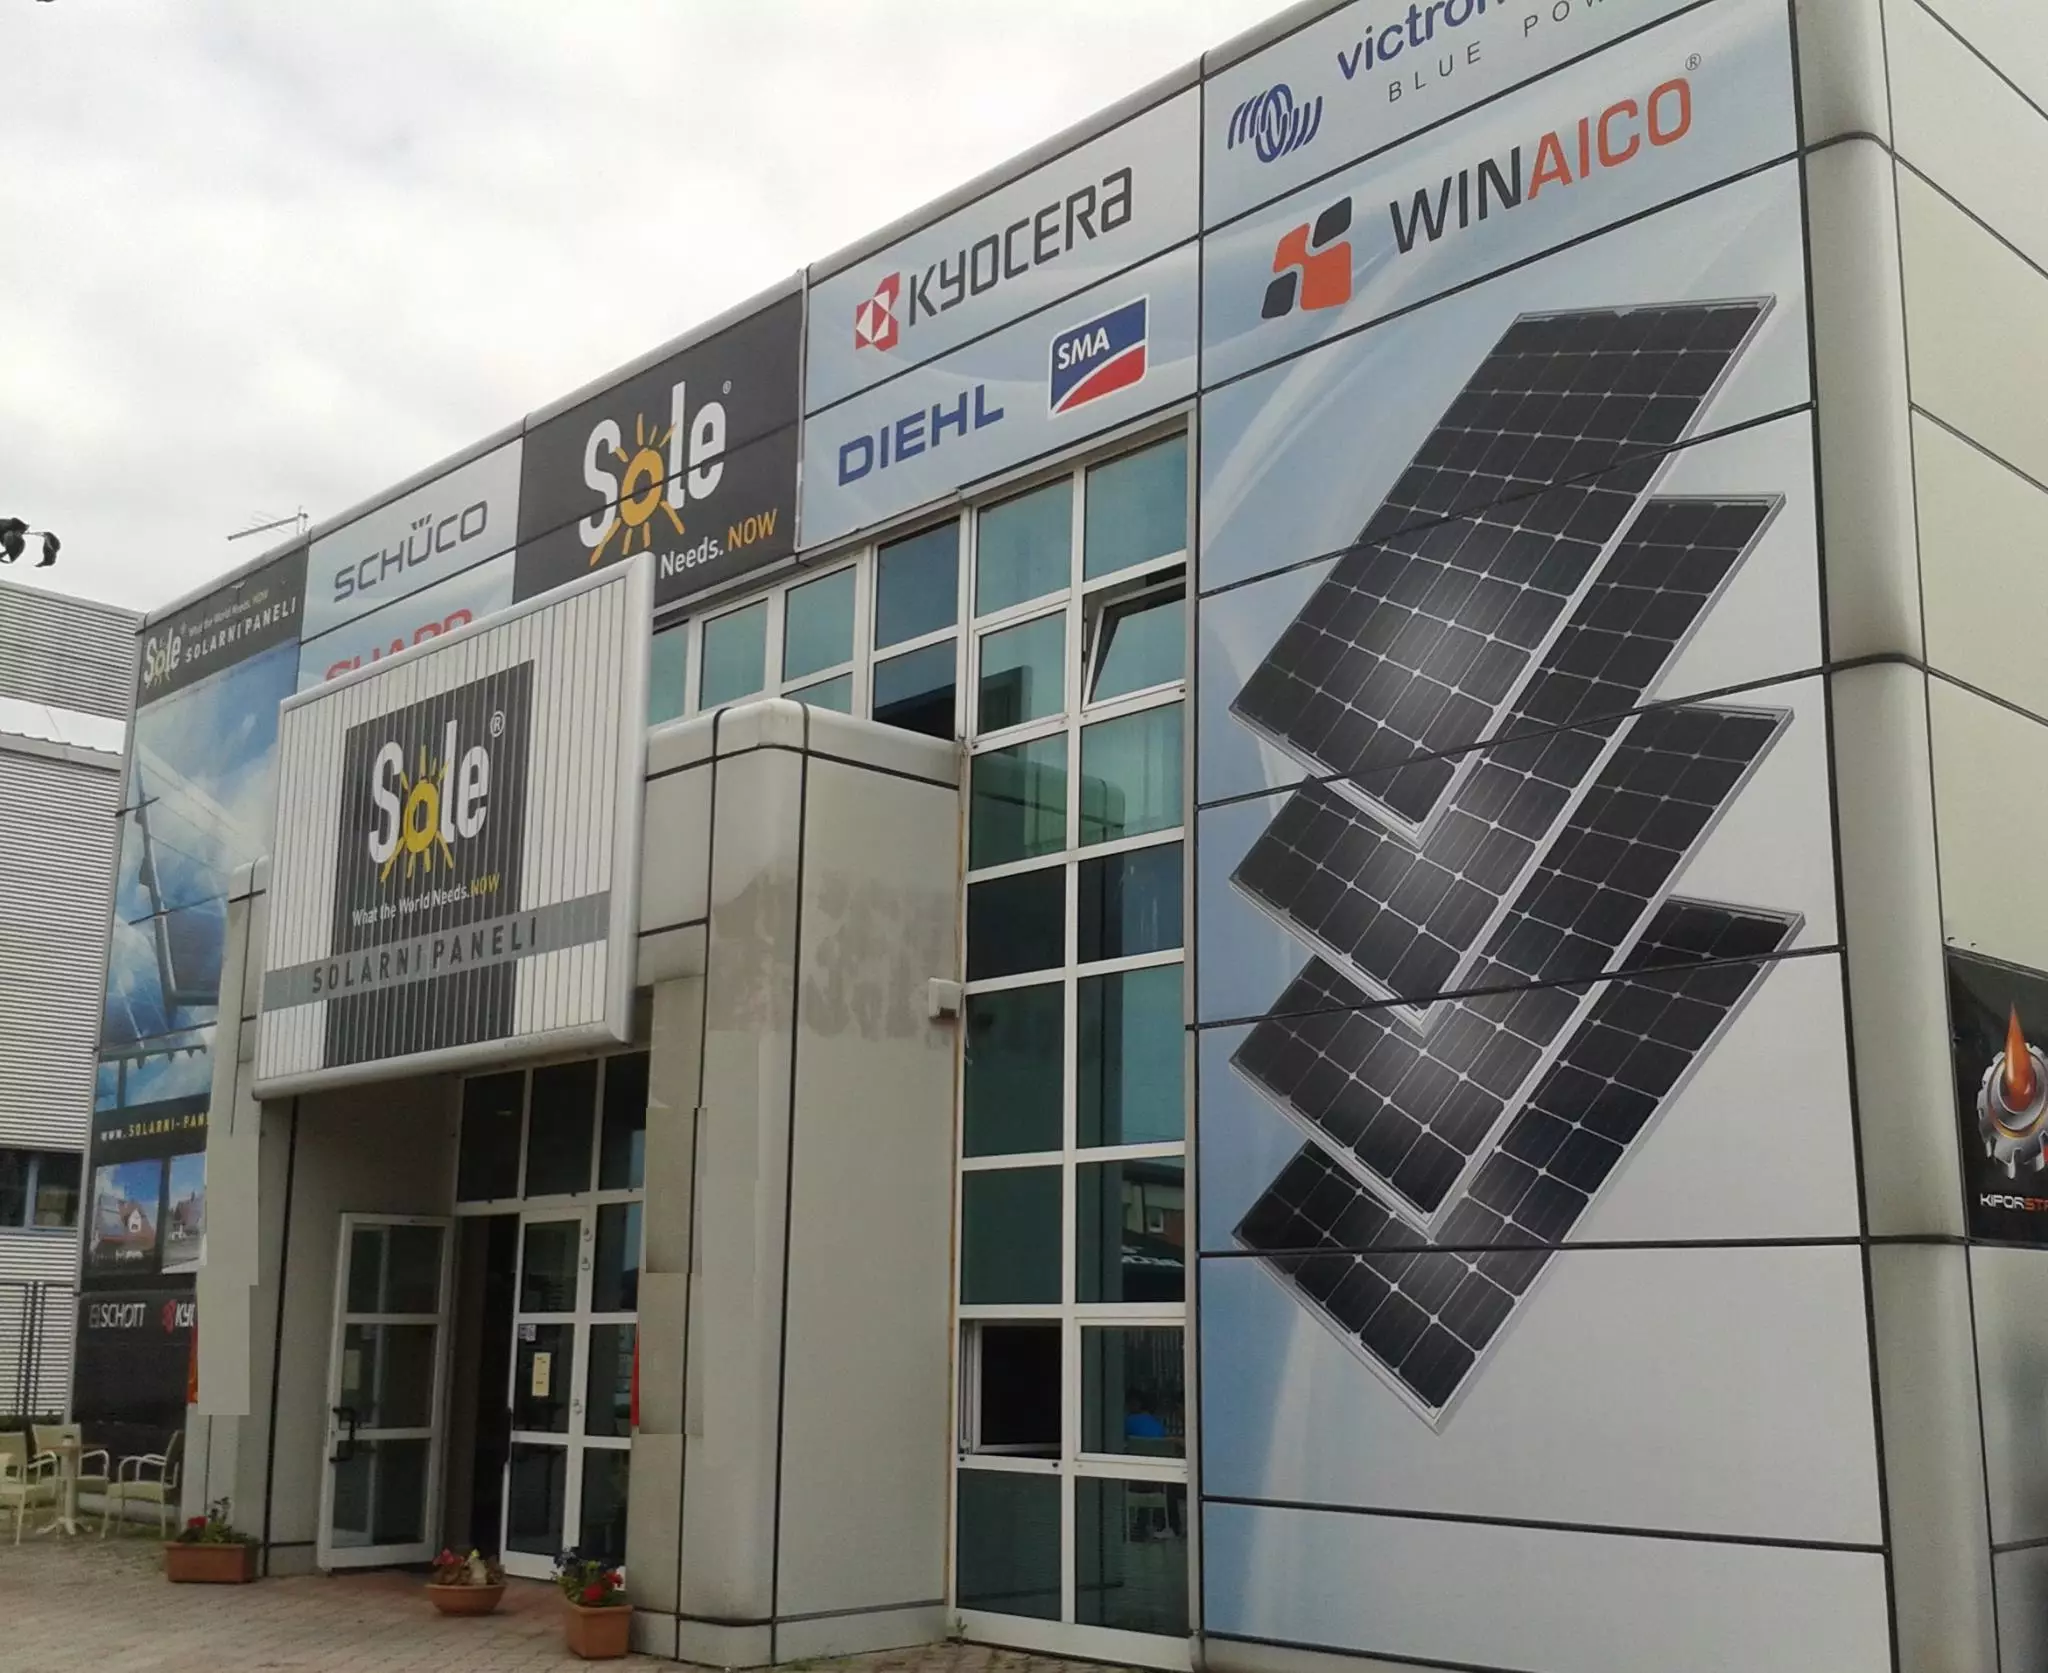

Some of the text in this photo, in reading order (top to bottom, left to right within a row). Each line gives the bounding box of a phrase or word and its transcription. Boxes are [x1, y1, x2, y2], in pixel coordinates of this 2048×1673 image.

[1388, 41, 1481, 103] BLUE
[1057, 327, 1111, 371] SMA
[579, 380, 727, 560] Sole
[838, 384, 1005, 487] DIEHL
[333, 500, 488, 603] SCHÜCO
[660, 508, 778, 580] Needs. NOW
[144, 627, 182, 687] Sole
[184, 622, 242, 663] SOLARNI
[245, 596, 297, 635] PANELI
[368, 719, 490, 866] Sole
[352, 872, 500, 927] What the World Needs. NOW
[311, 915, 538, 994] SOLARNI PANELI
[101, 1303, 146, 1328] SCHOTT
